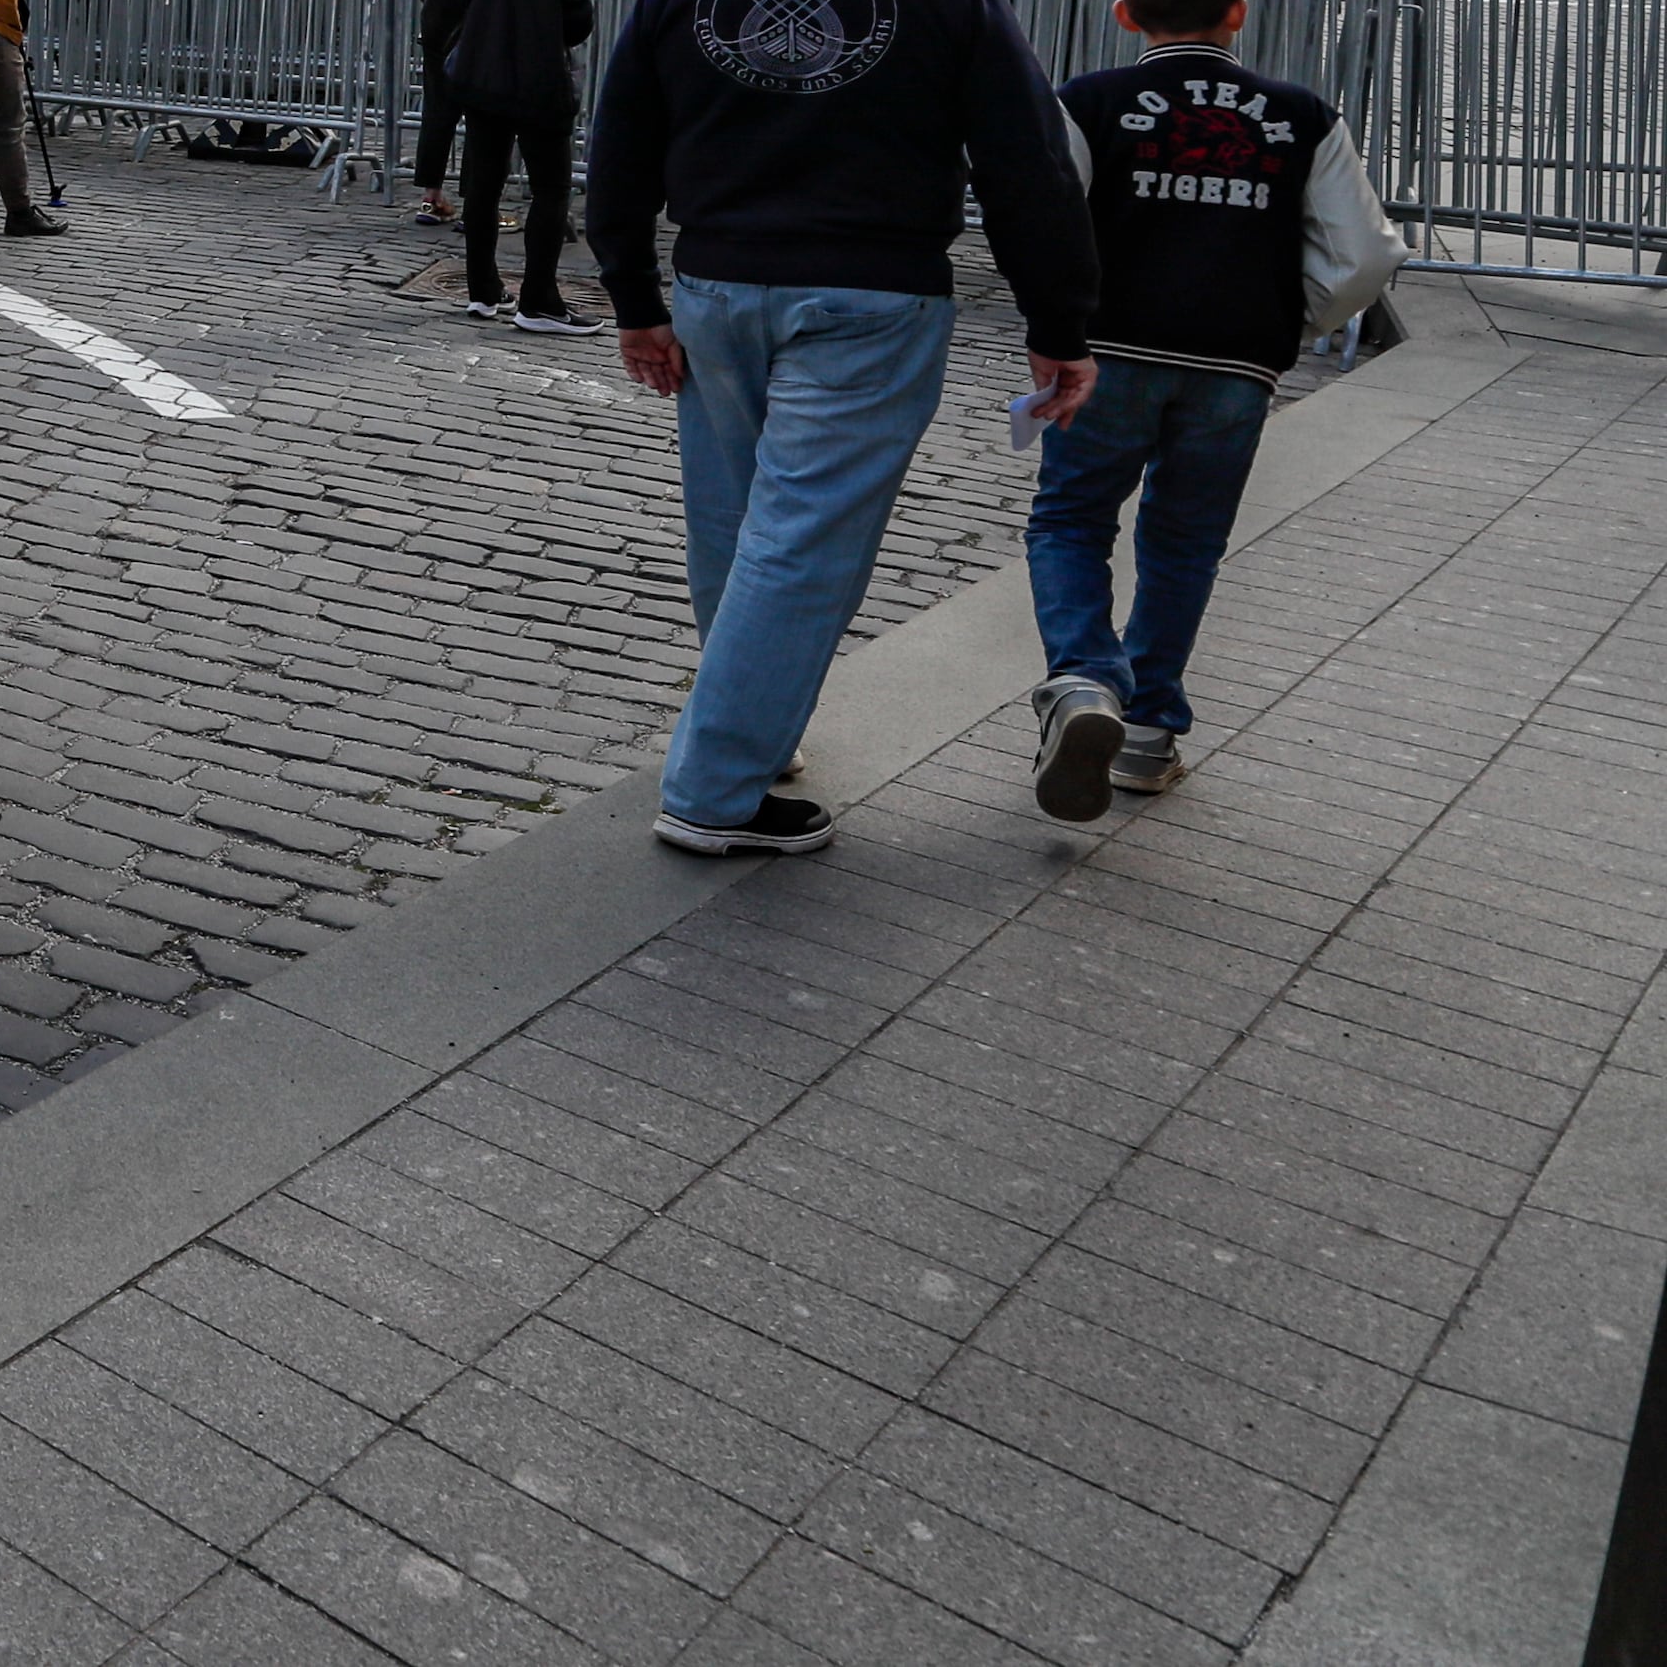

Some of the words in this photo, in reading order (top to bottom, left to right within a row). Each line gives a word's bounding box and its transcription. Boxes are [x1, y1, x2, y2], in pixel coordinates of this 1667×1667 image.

[1120, 90, 1169, 131] GO
[1183, 80, 1295, 144] TEAM
[1132, 170, 1270, 210] TIGERS
